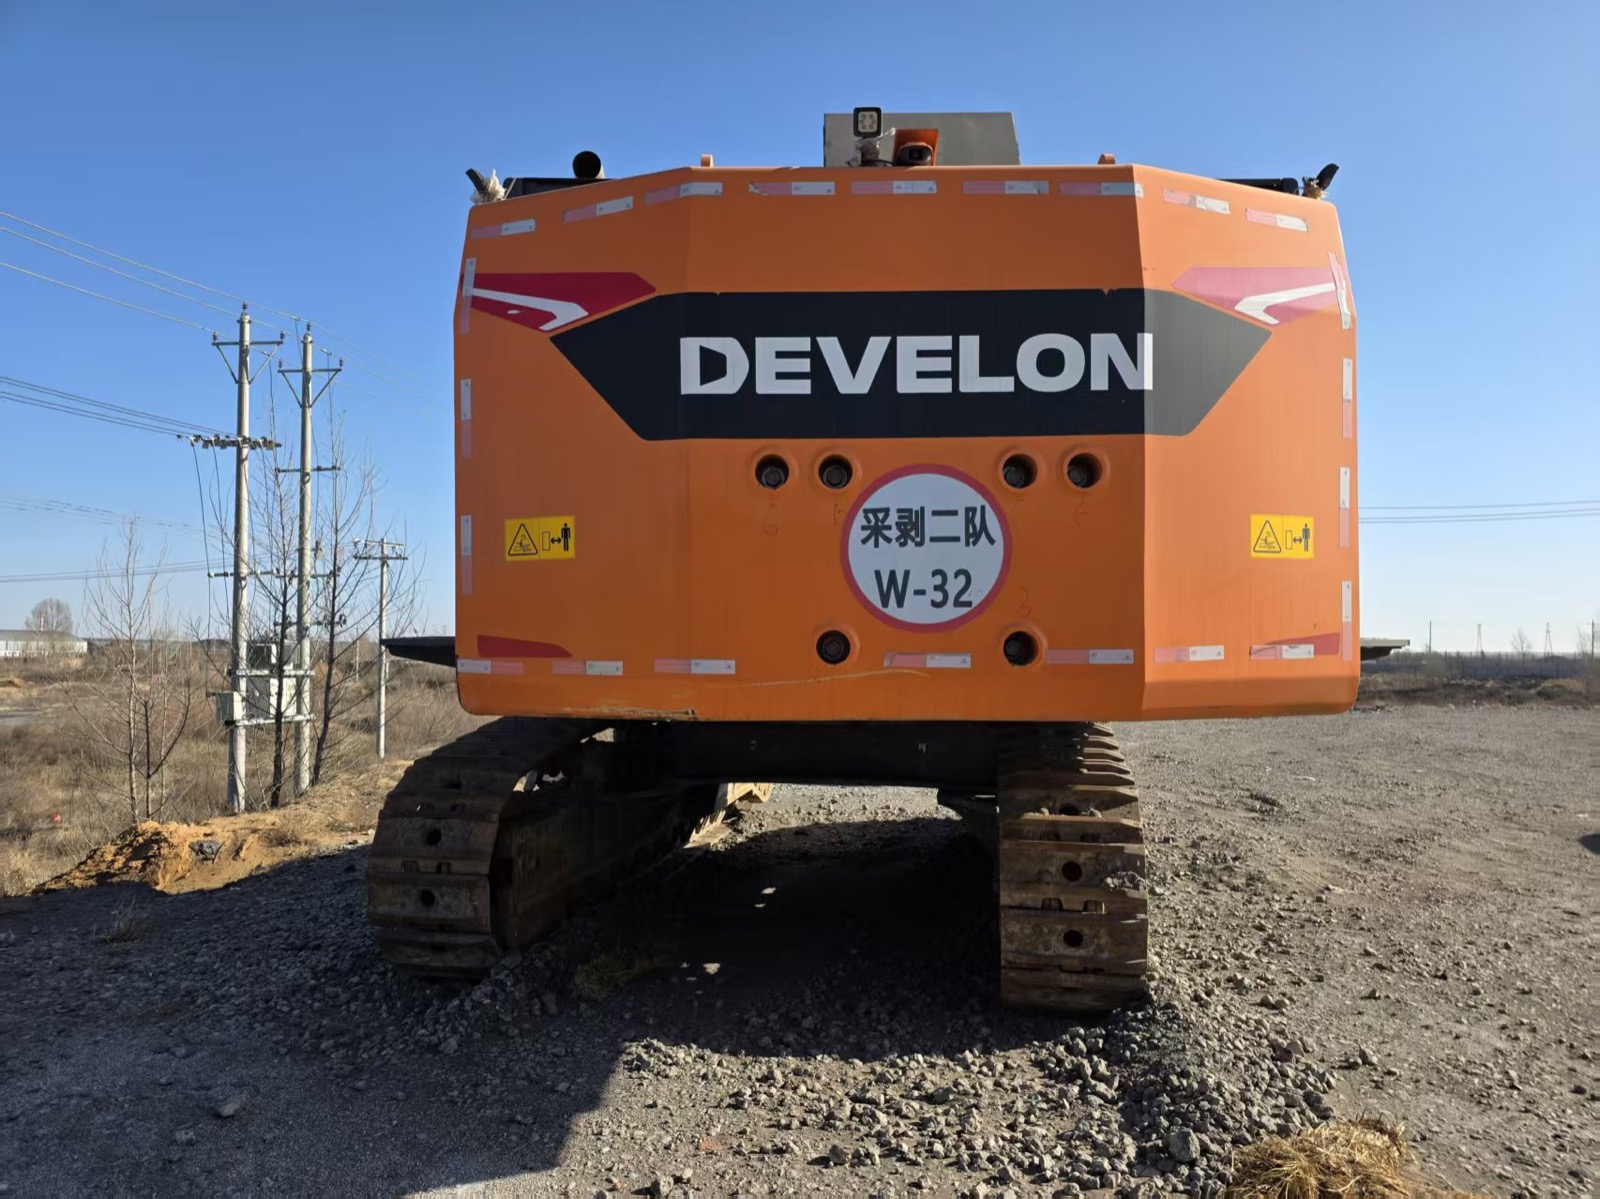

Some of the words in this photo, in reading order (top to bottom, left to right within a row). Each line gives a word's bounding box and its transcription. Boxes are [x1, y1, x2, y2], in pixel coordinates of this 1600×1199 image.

[679, 332, 1154, 396] DEVELON
[860, 504, 996, 549] 采剥二队
[874, 568, 973, 609] W-32
